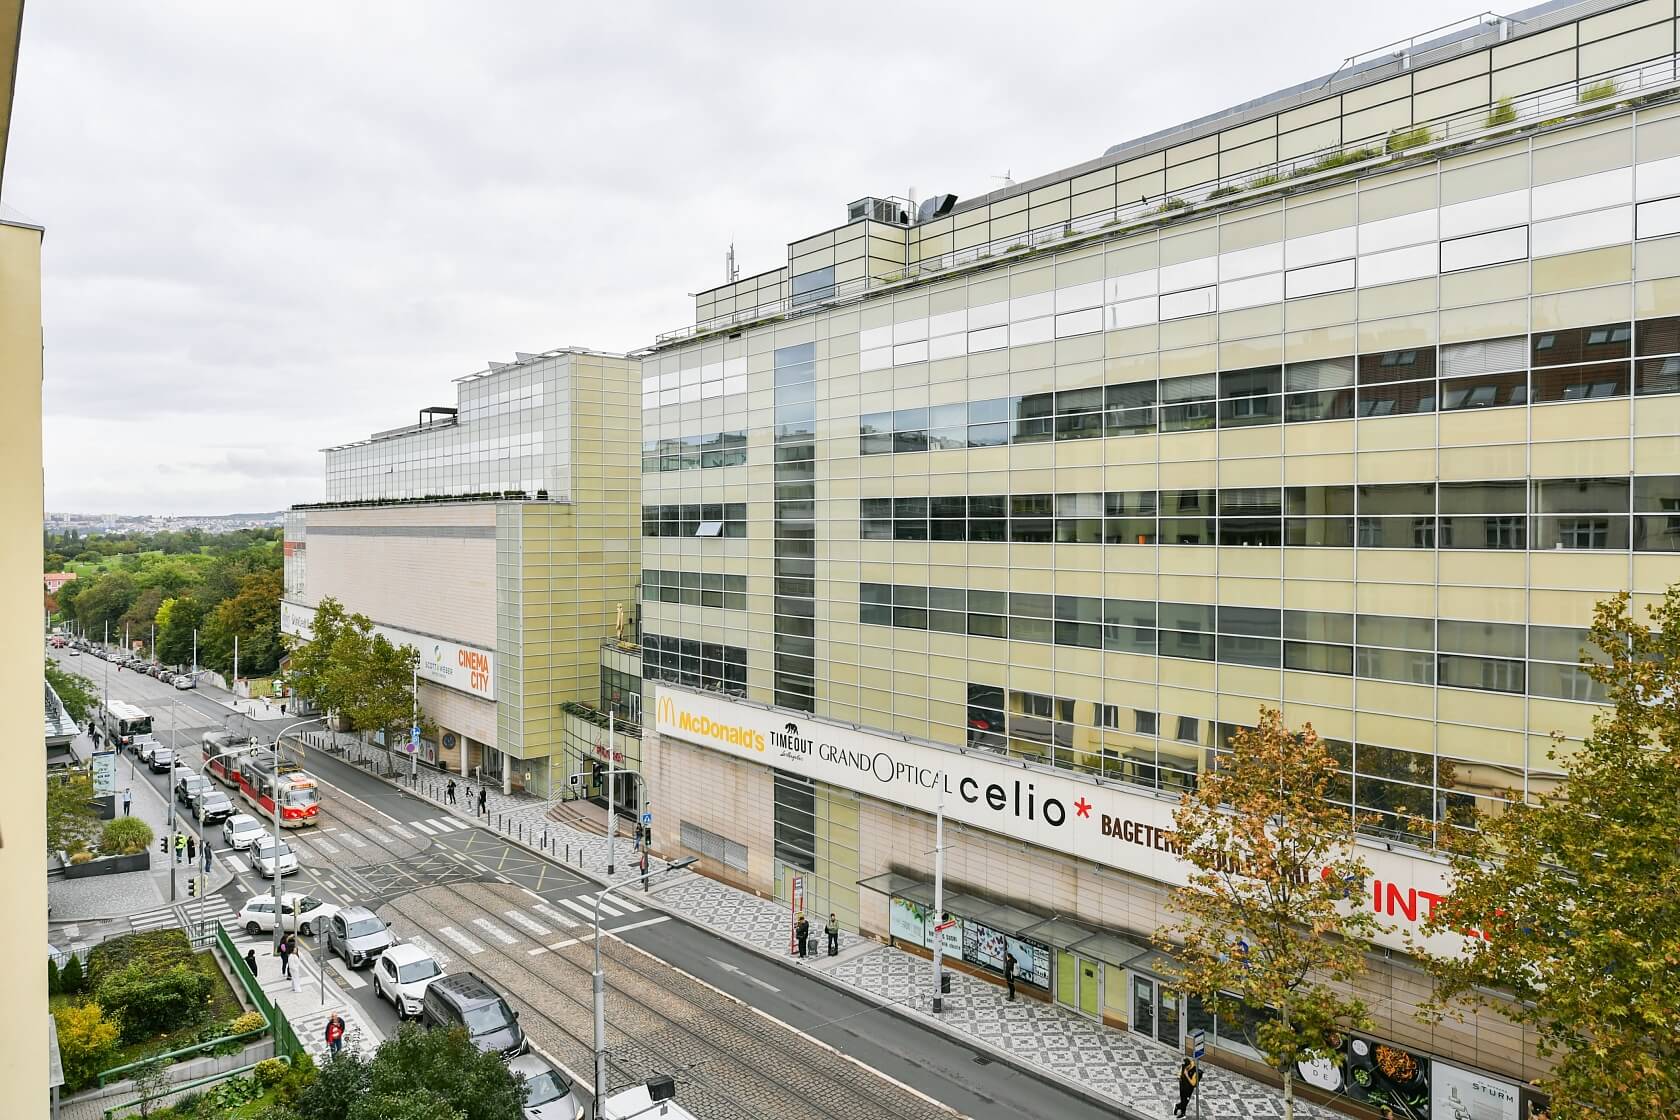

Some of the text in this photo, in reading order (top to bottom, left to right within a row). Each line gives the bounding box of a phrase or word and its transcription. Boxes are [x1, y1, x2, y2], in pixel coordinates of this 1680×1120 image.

[458, 650, 488, 673] CINEMA
[471, 670, 489, 692] CITY
[679, 711, 765, 752] McDonald's
[770, 731, 814, 755] TIMEOUT
[1472, 1082, 1514, 1103] STURM
